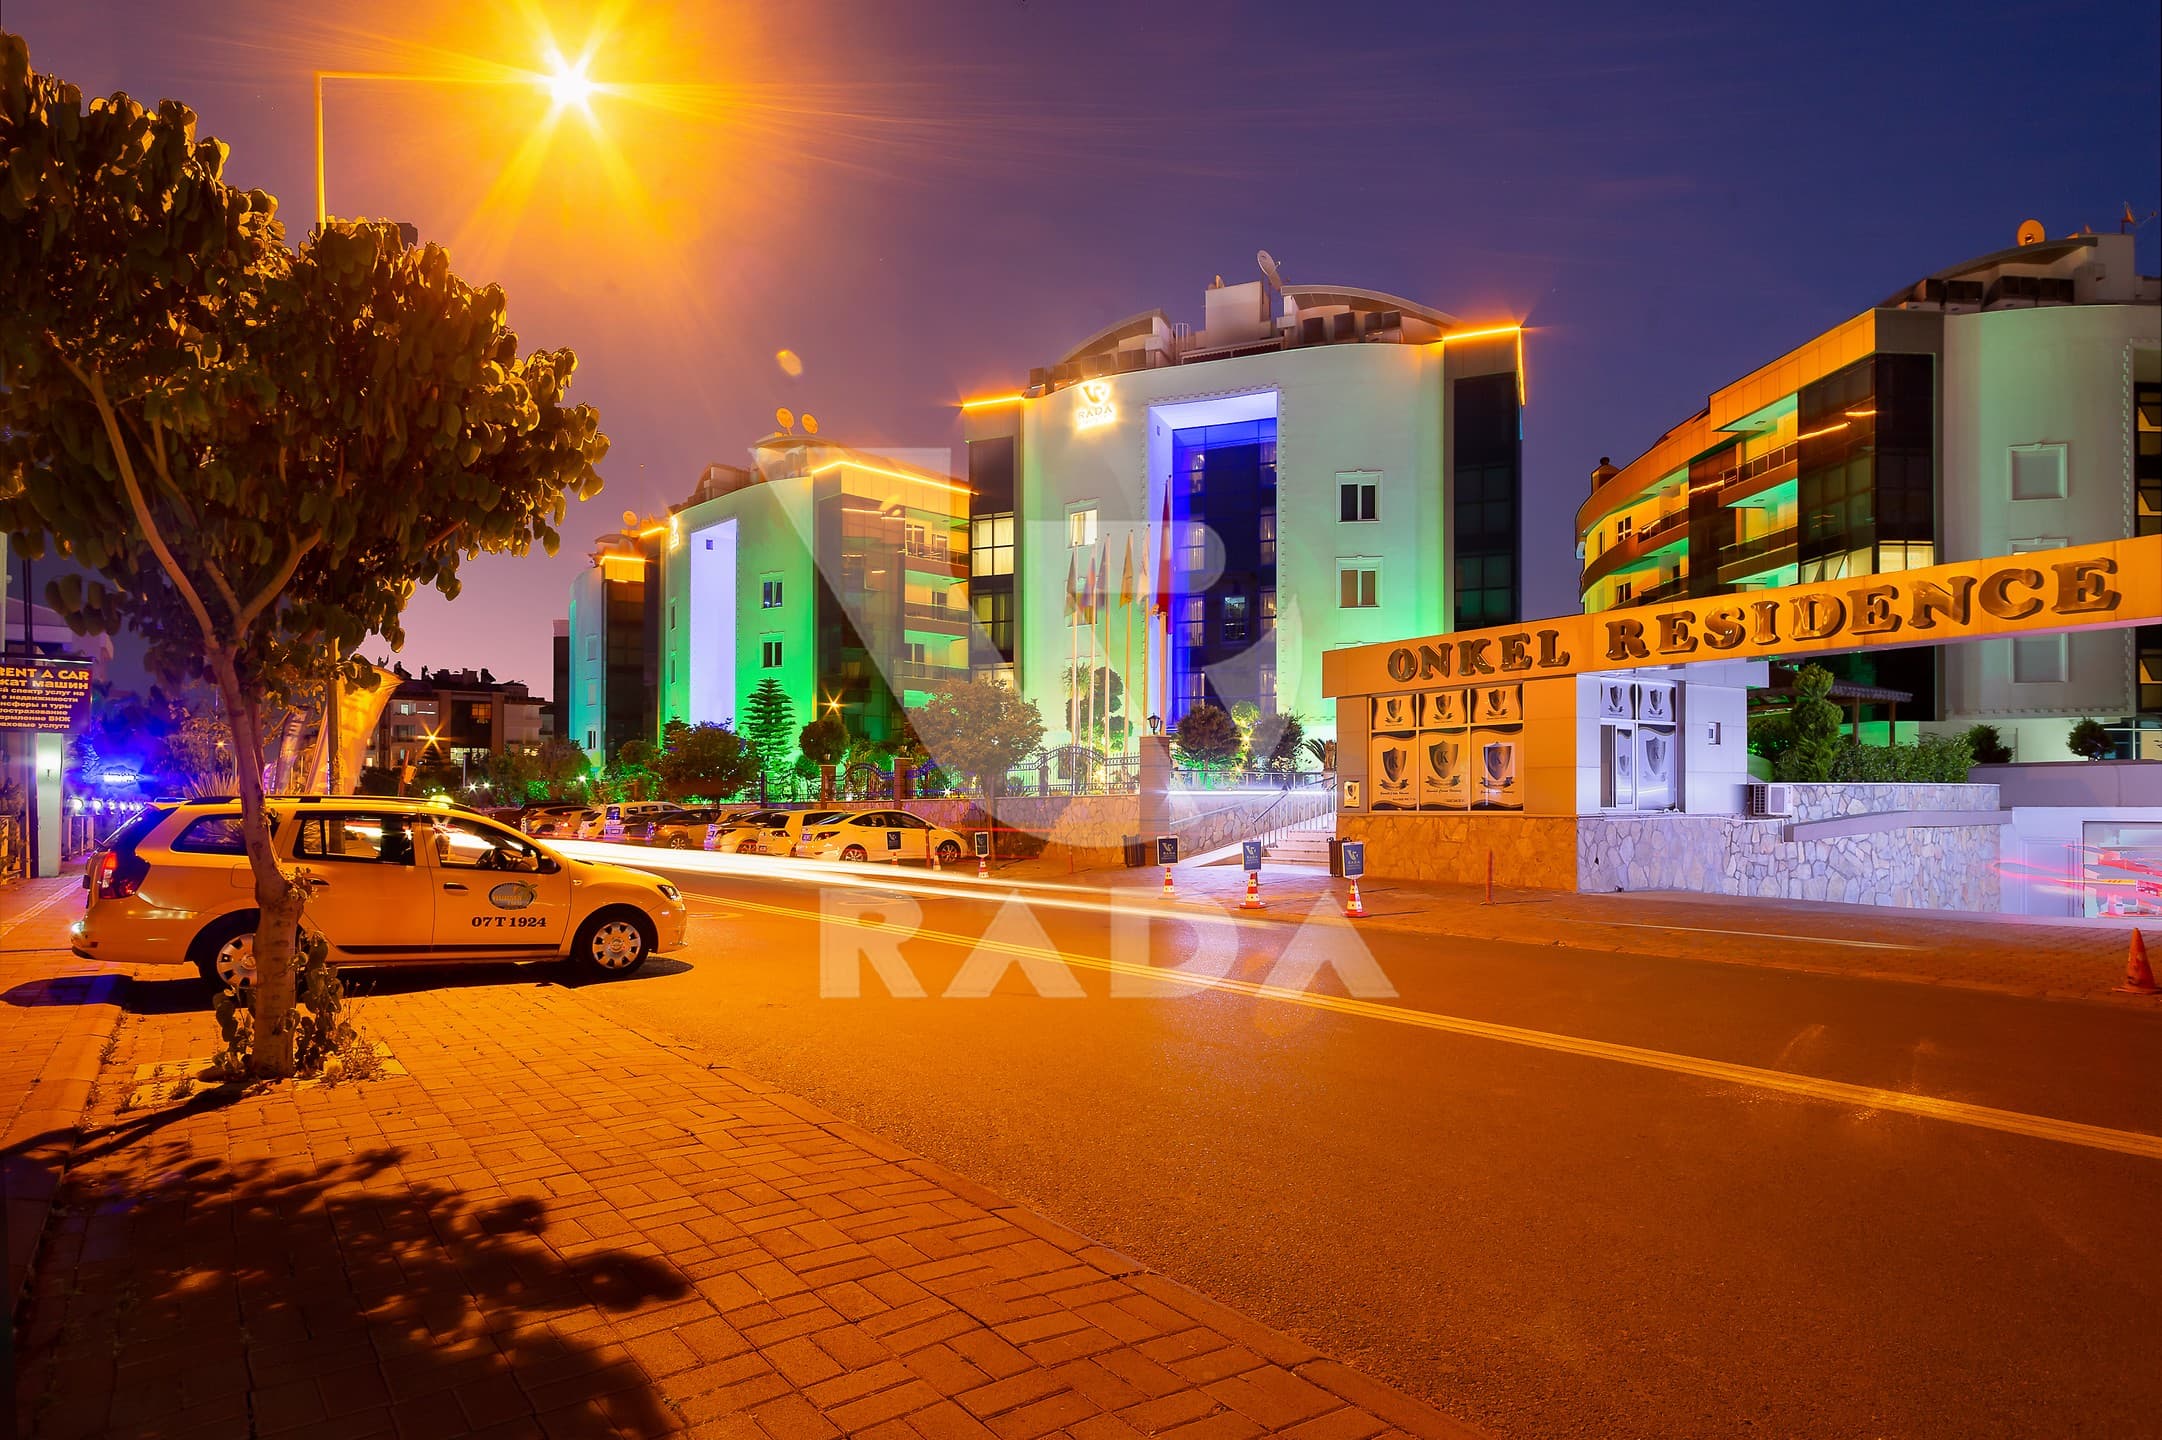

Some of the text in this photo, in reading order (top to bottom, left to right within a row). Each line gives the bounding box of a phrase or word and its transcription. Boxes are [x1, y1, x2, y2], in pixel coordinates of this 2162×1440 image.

[1078, 405, 1113, 419] RADA
[1387, 556, 2122, 682] ONKEL RESIDENCE
[41, 669, 54, 678] A
[58, 669, 89, 680] CAR
[32, 681, 89, 689] машин
